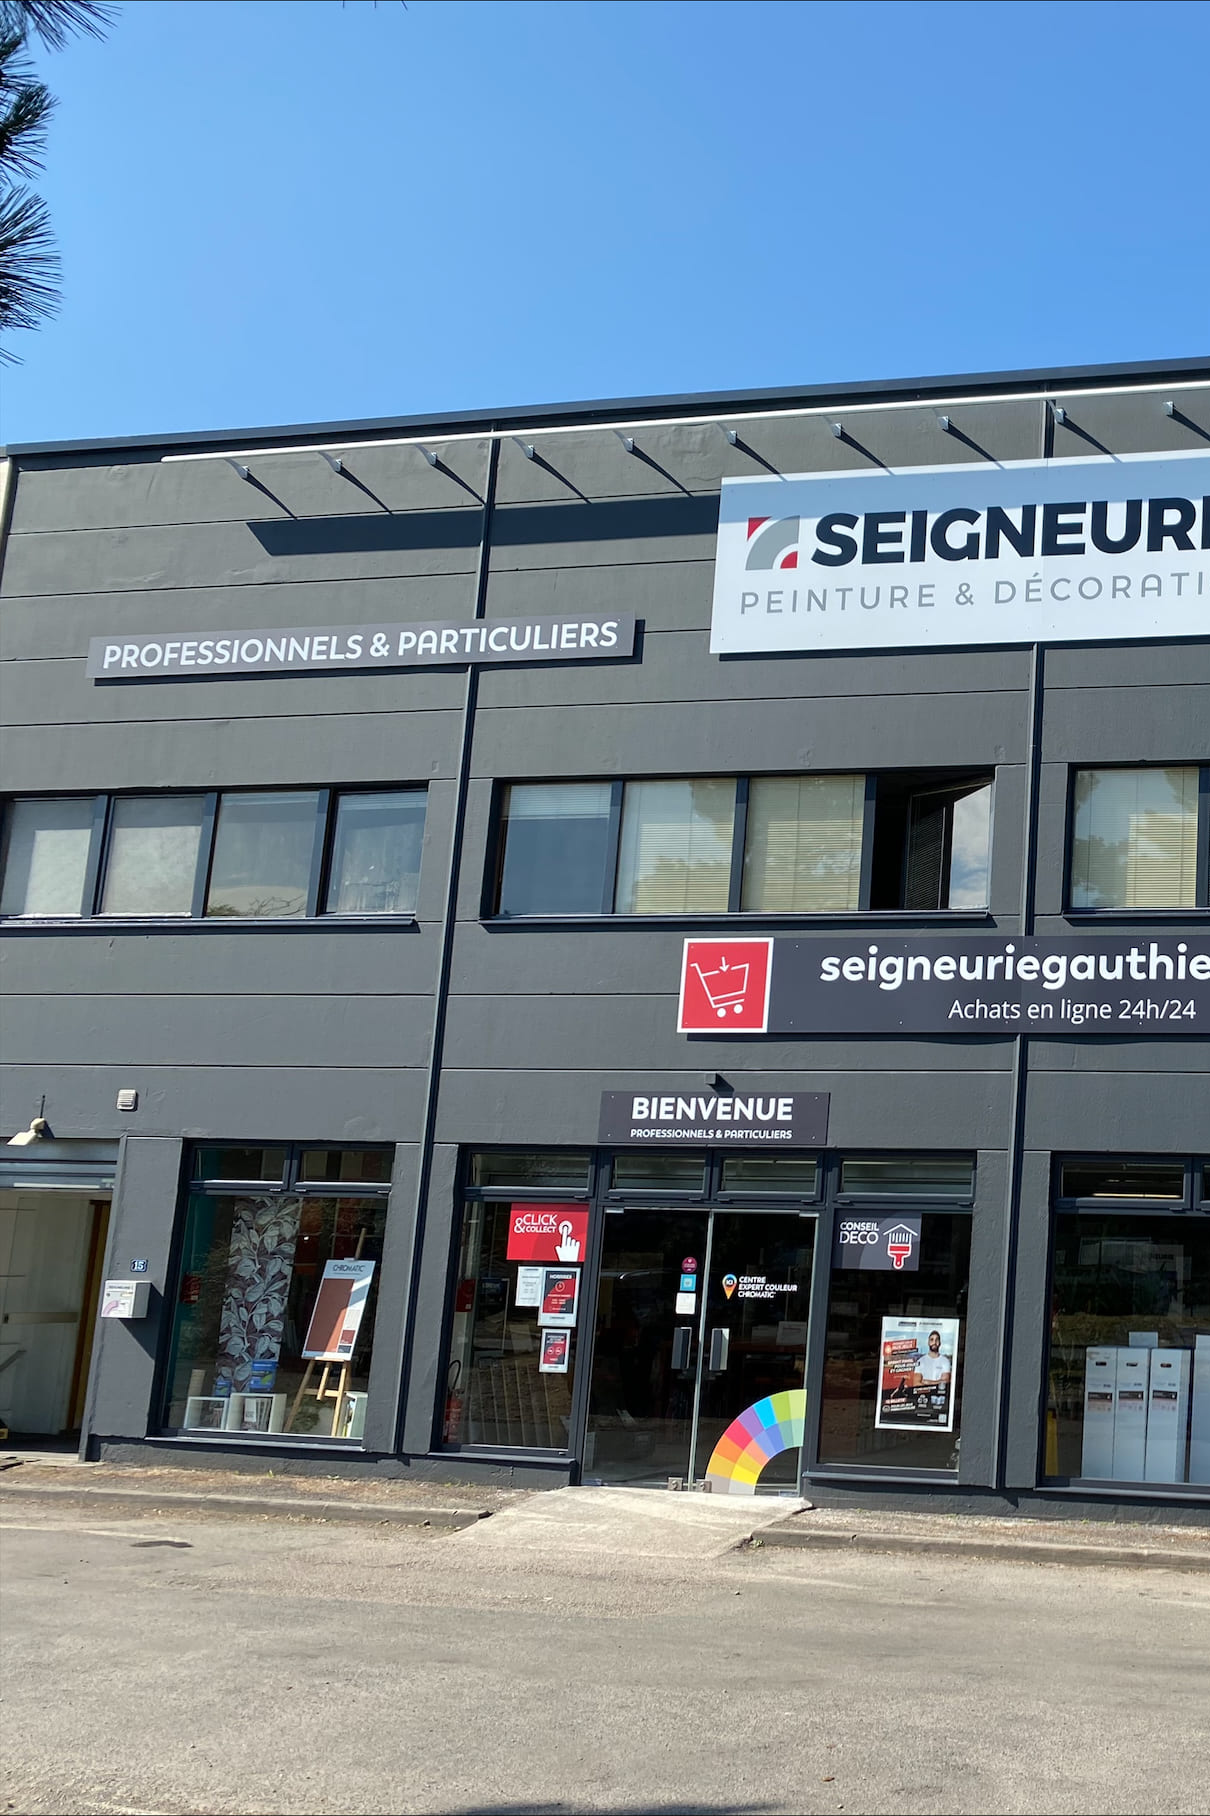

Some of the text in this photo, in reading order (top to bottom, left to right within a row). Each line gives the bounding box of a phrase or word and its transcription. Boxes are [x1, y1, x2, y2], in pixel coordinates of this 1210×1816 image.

[740, 583, 936, 615] PEINTURE
[955, 582, 975, 606] &
[102, 621, 618, 670] PROFESSIONNELS & PARTICULIERS
[948, 998, 1198, 1024] Achats en ligne 24h/24
[631, 1096, 794, 1121] BIENVENUE
[630, 1128, 793, 1140] PROFESSIONNELS & PARTICULIERS
[513, 1217, 557, 1233] & COLLECT
[523, 1213, 558, 1226] CLICK
[840, 1222, 880, 1231] CONSEIL
[839, 1231, 879, 1245] DECO
[739, 1276, 766, 1284] CENTRE
[738, 1283, 798, 1292] EXPERT COULEUR
